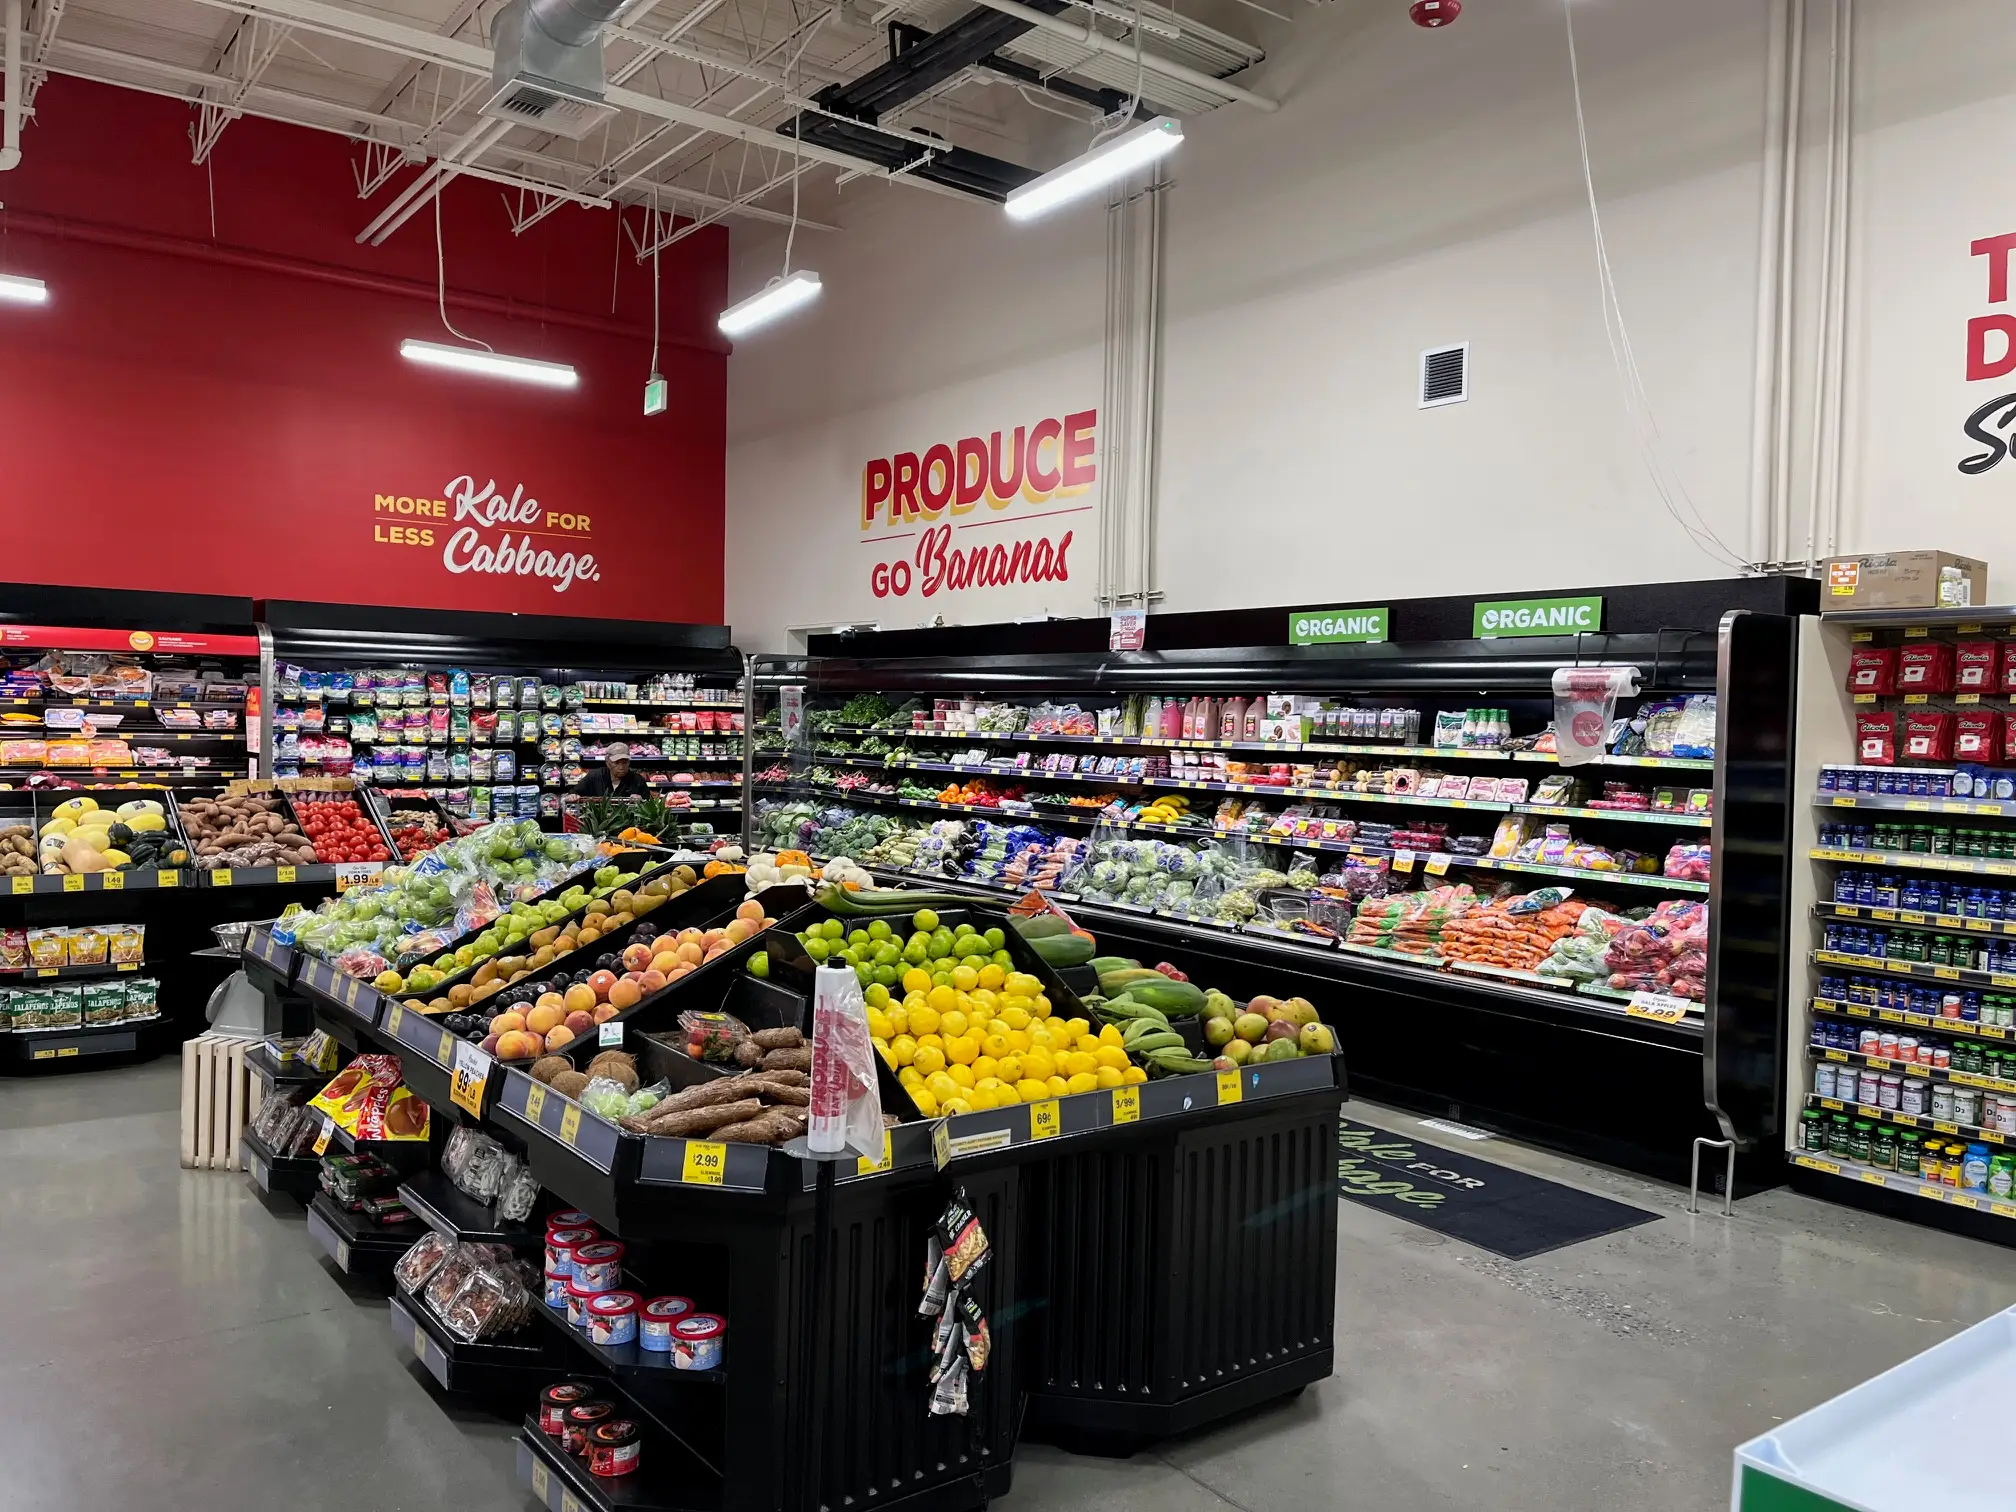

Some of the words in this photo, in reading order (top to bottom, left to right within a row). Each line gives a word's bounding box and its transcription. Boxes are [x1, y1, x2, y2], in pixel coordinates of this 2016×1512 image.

[862, 408, 1097, 526] PRODUCE
[374, 494, 447, 518] MORE
[443, 474, 542, 528] Kale
[546, 511, 591, 532] FOR
[374, 525, 435, 547] LESS
[443, 526, 601, 592] Cabbage.
[871, 560, 912, 598] GO
[915, 524, 1073, 597] Bananas
[1296, 616, 1380, 637] ORGANIC
[1481, 606, 1591, 630] ORGANIC
[693, 1153, 719, 1168] $2.99
[1406, 1162, 1485, 1189] FOR
